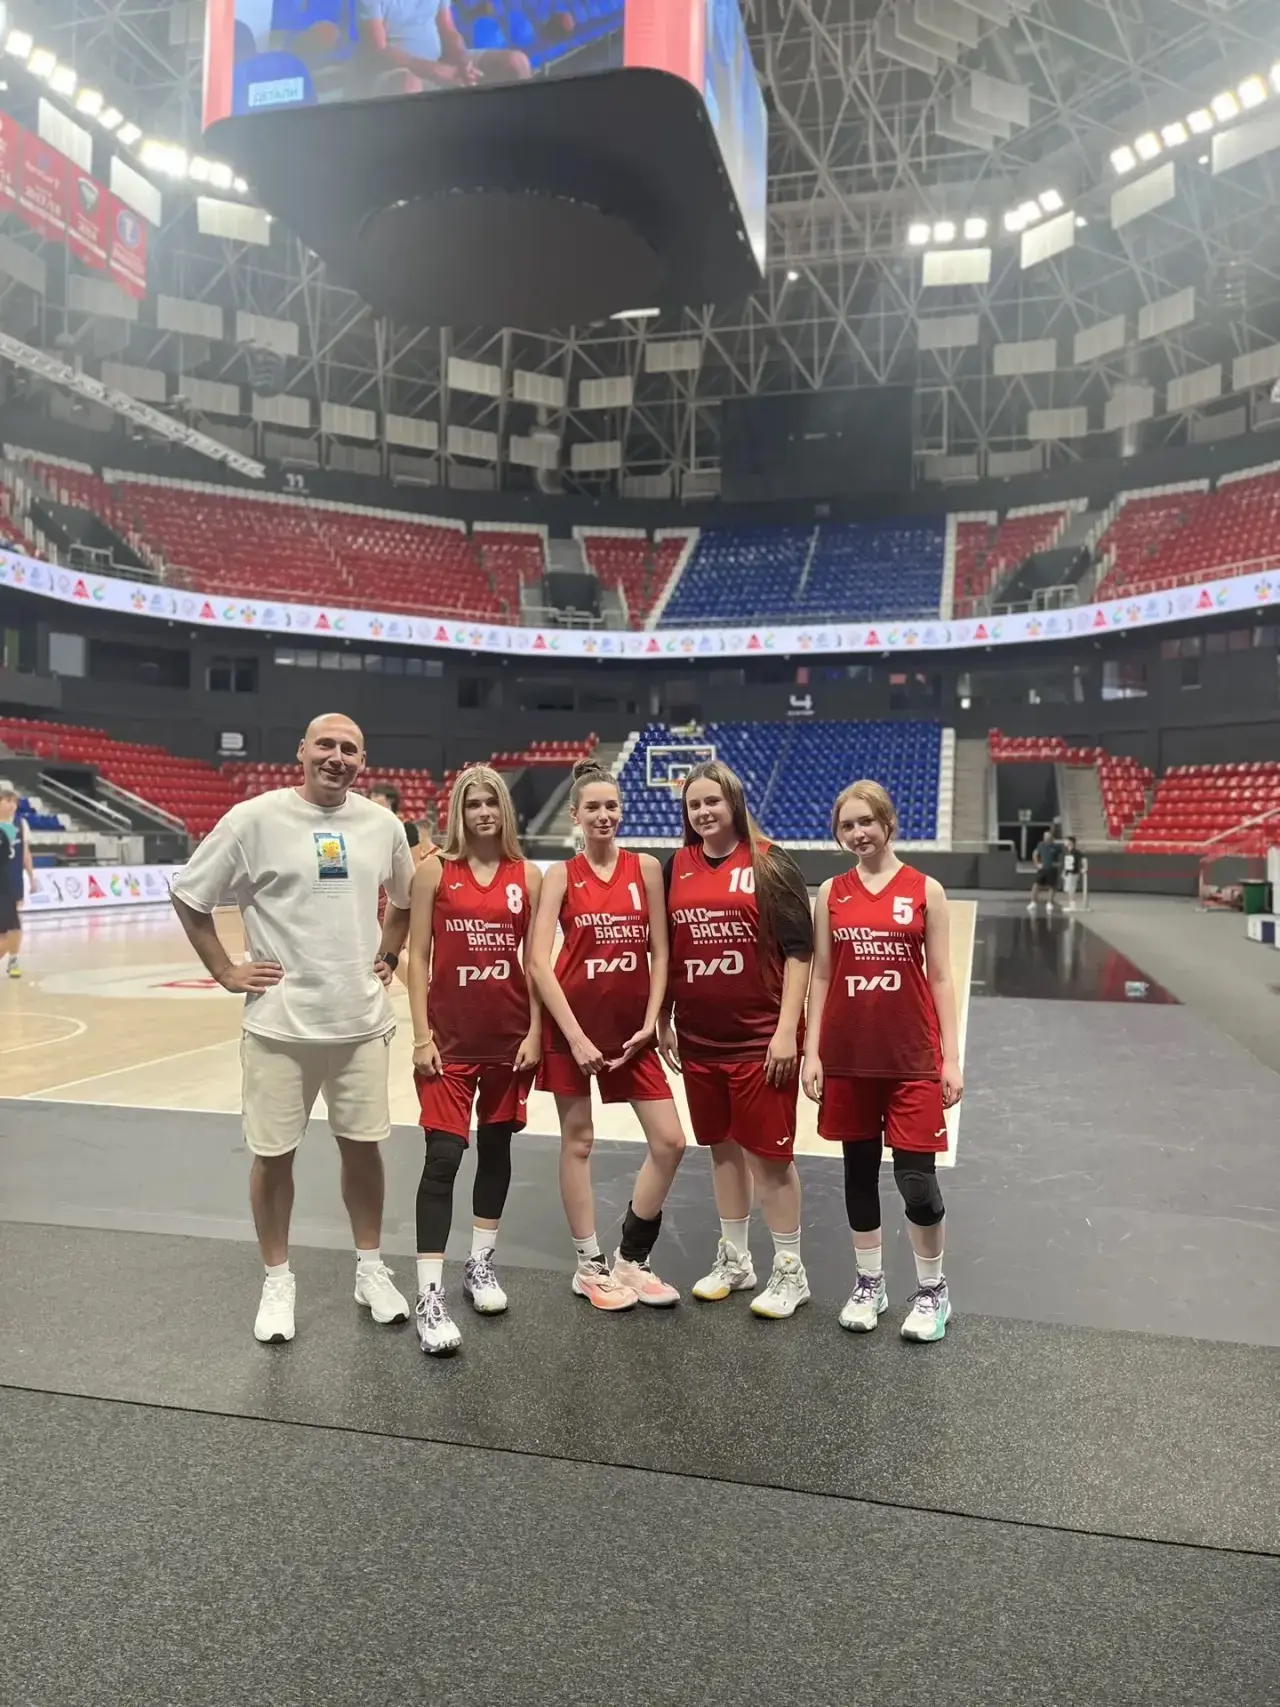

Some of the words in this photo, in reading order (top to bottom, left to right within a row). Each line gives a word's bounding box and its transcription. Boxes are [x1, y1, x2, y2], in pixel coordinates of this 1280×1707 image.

[790, 694, 812, 709] 4
[728, 866, 755, 894] 10
[506, 883, 523, 914] 8
[627, 882, 642, 911] 1
[893, 895, 914, 926] 5
[467, 933, 516, 946] БАСКЕ
[690, 921, 752, 938] БАСКЕТ
[852, 941, 913, 956] БАСКЕТ
